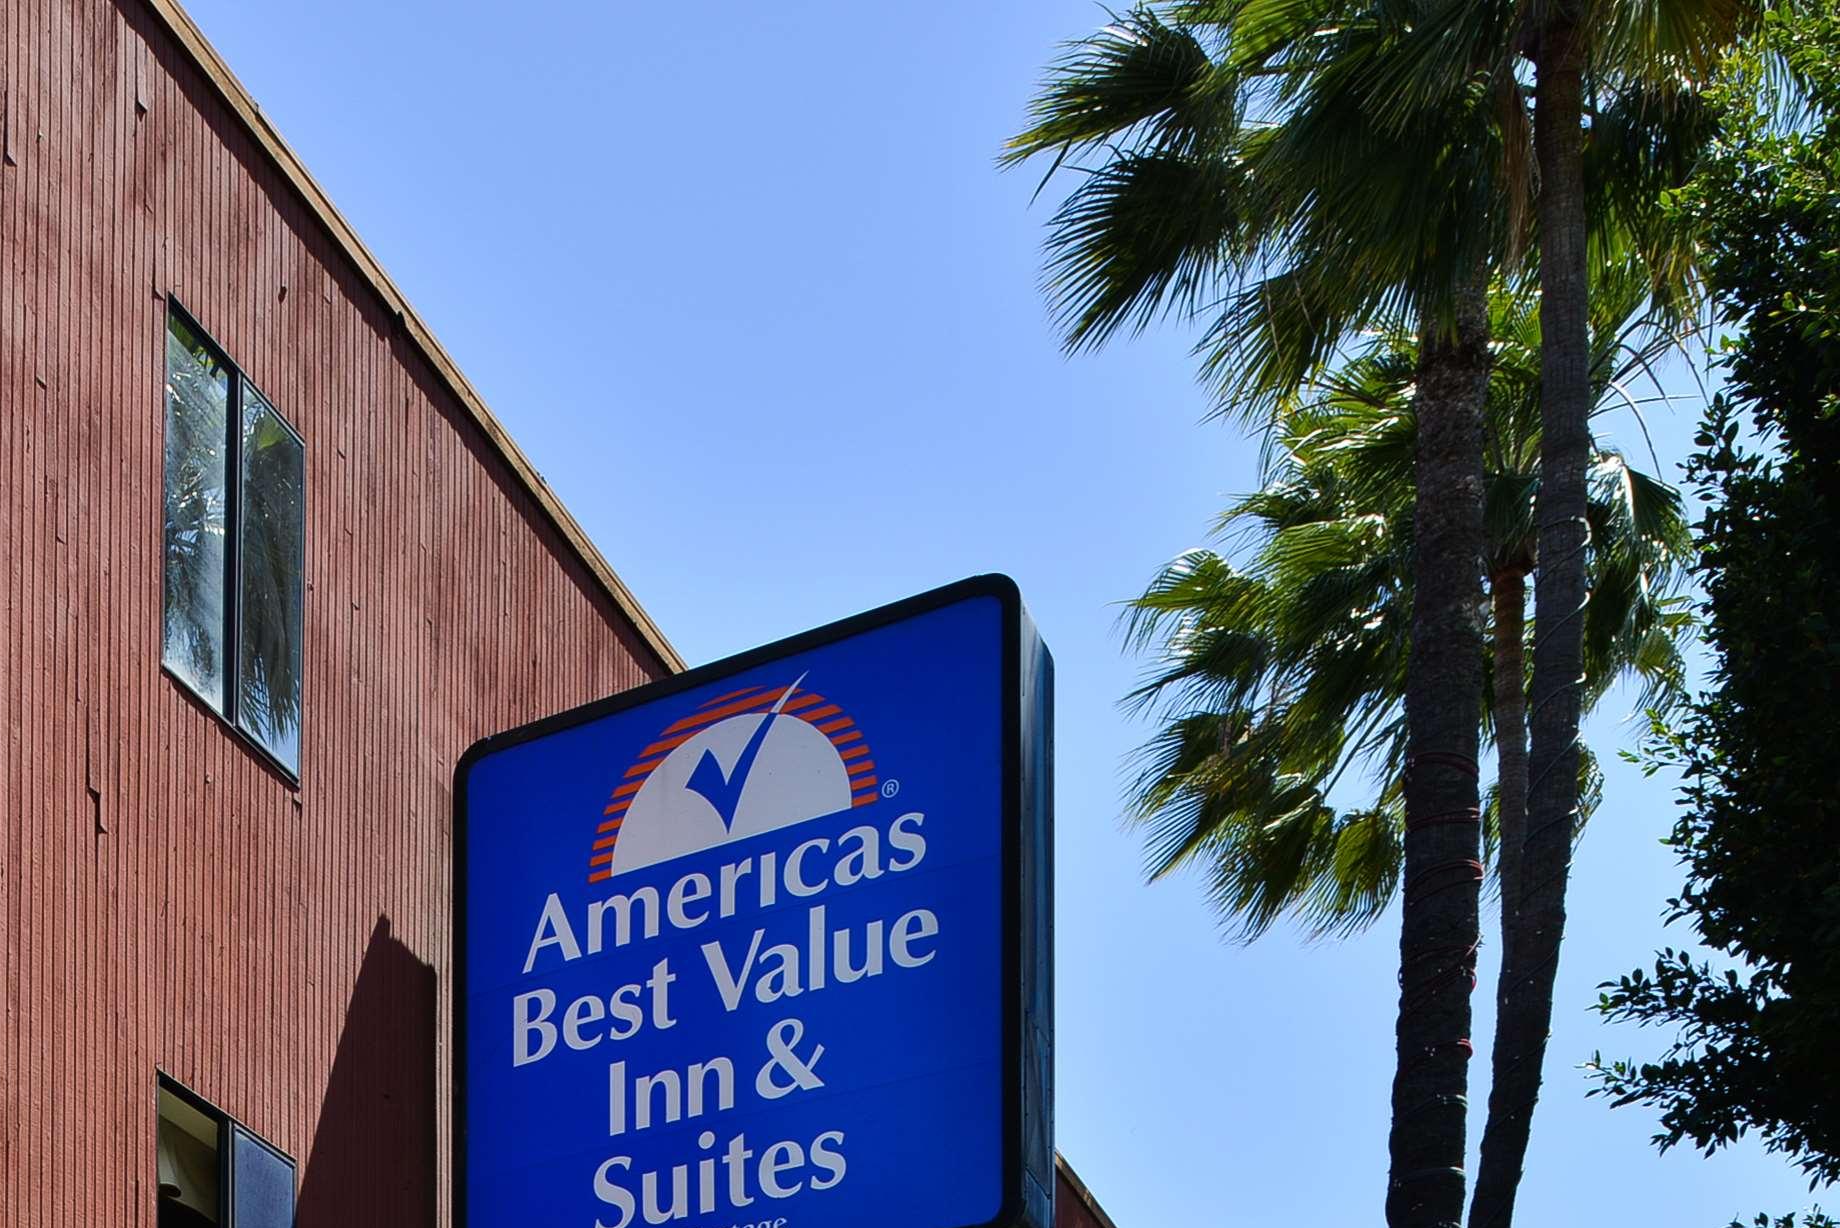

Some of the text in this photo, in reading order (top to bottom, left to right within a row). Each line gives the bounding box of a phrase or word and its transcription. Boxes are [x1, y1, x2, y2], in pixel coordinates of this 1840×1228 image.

[523, 812, 926, 974] Americas
[513, 905, 938, 1067] Best Value
[610, 1018, 825, 1136] Inn &
